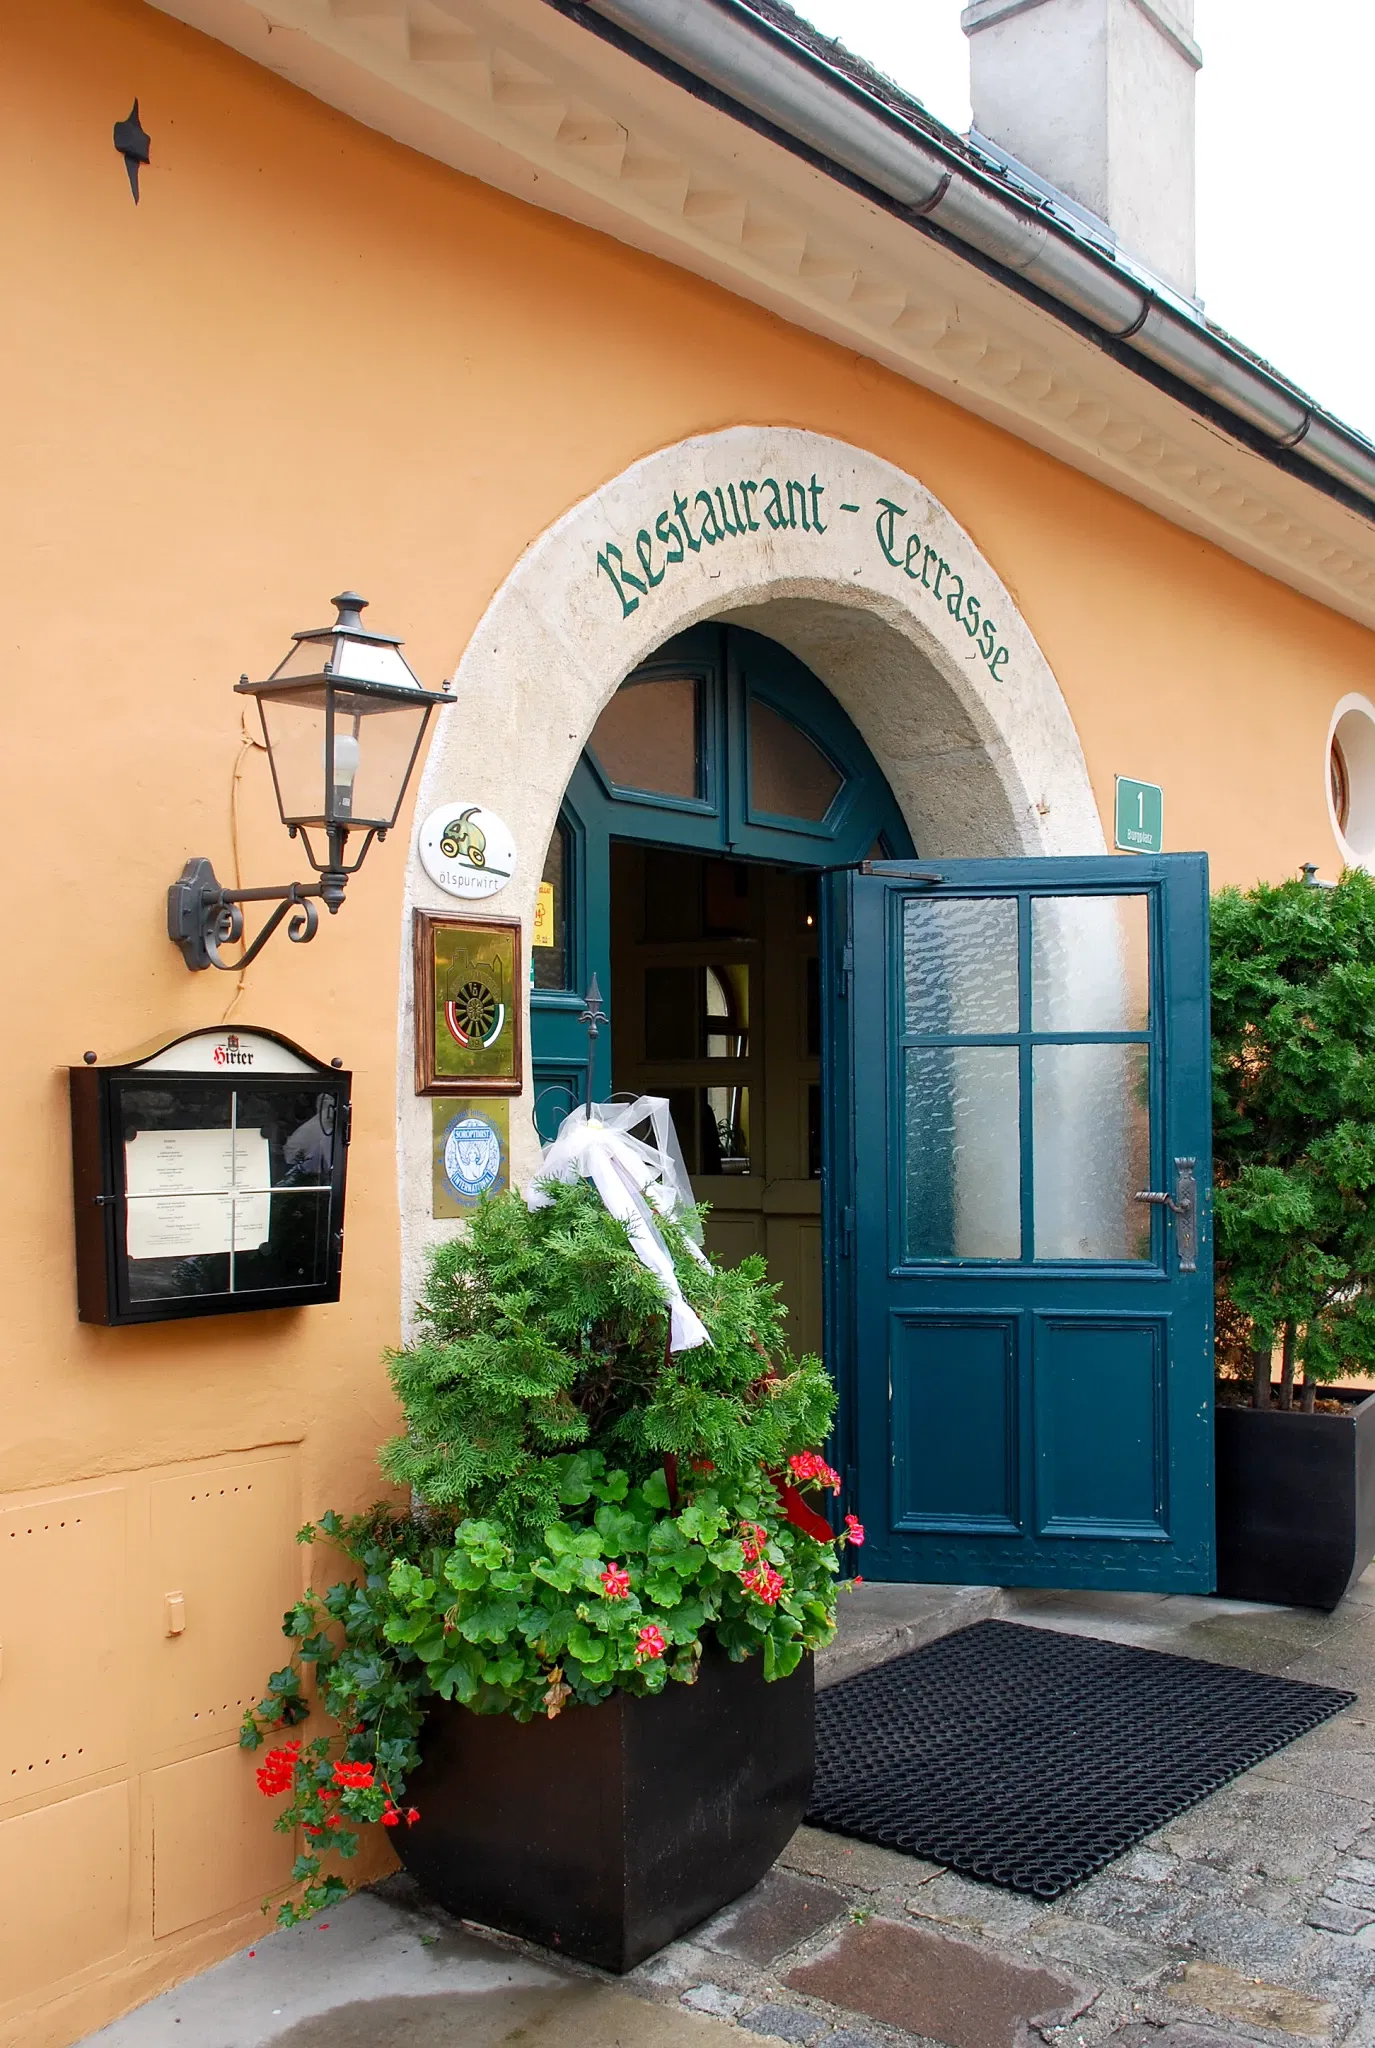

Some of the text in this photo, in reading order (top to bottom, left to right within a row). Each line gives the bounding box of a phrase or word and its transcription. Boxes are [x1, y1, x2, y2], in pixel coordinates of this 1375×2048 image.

[597, 473, 827, 620] Restaurant
[875, 497, 1010, 683] Terrasse
[1137, 791, 1143, 828] 1
[1127, 829, 1153, 844] Burgplatz
[439, 871, 500, 890] ölspurwirt
[214, 1046, 254, 1065] Hirter
